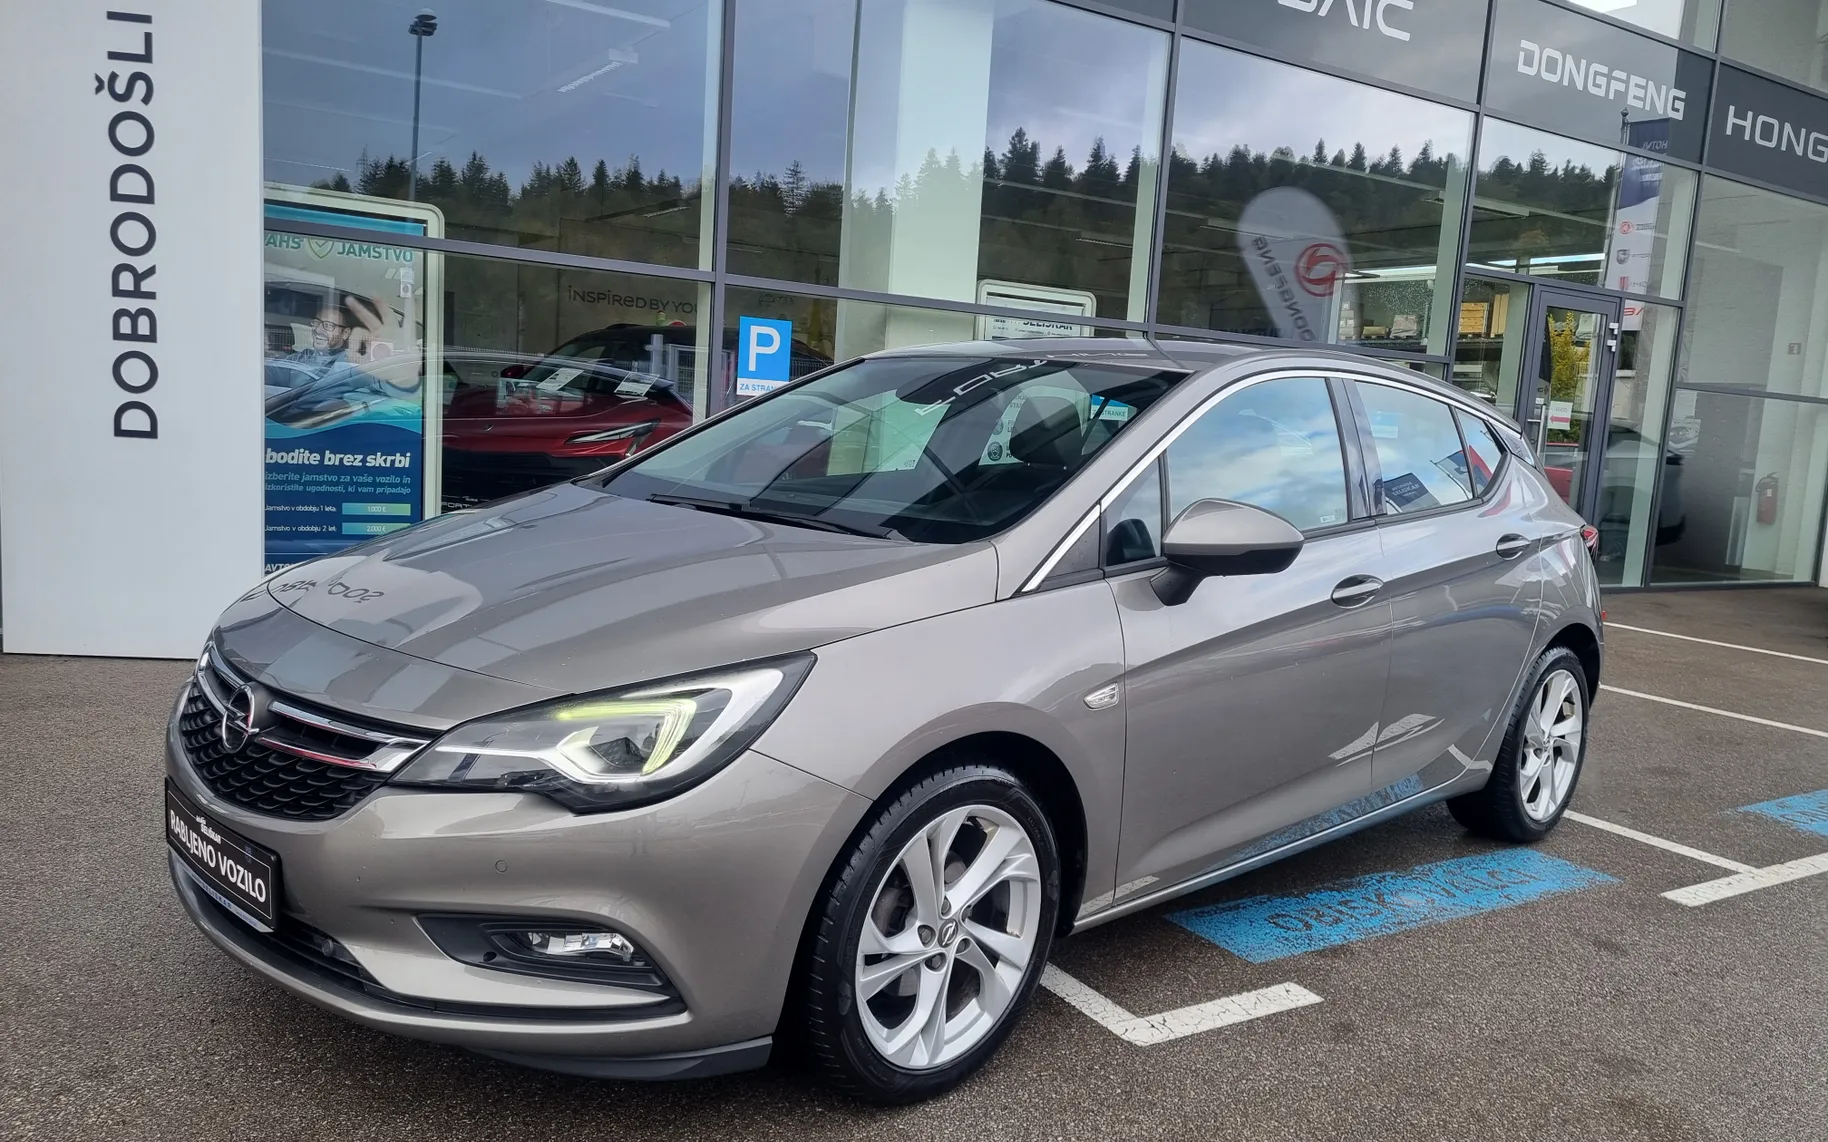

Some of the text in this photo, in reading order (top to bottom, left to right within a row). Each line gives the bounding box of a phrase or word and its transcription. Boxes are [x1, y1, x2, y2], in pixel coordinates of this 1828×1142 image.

[1517, 39, 1686, 120] DONGFENG
[94, 10, 159, 440] DOBRODOŠLI
[337, 242, 414, 262] JAMSTVO
[649, 298, 669, 311] BY
[748, 325, 780, 371] P
[740, 383, 750, 391] ZA
[265, 448, 411, 468] bodite brez skrbi
[265, 472, 300, 481] izberite
[301, 472, 338, 483] jamstvo
[352, 474, 374, 483] vaše
[376, 475, 401, 484] vozilo
[402, 475, 411, 484] in
[376, 486, 411, 495] pripadajo
[170, 809, 266, 903] RABLJENO VOZILO
